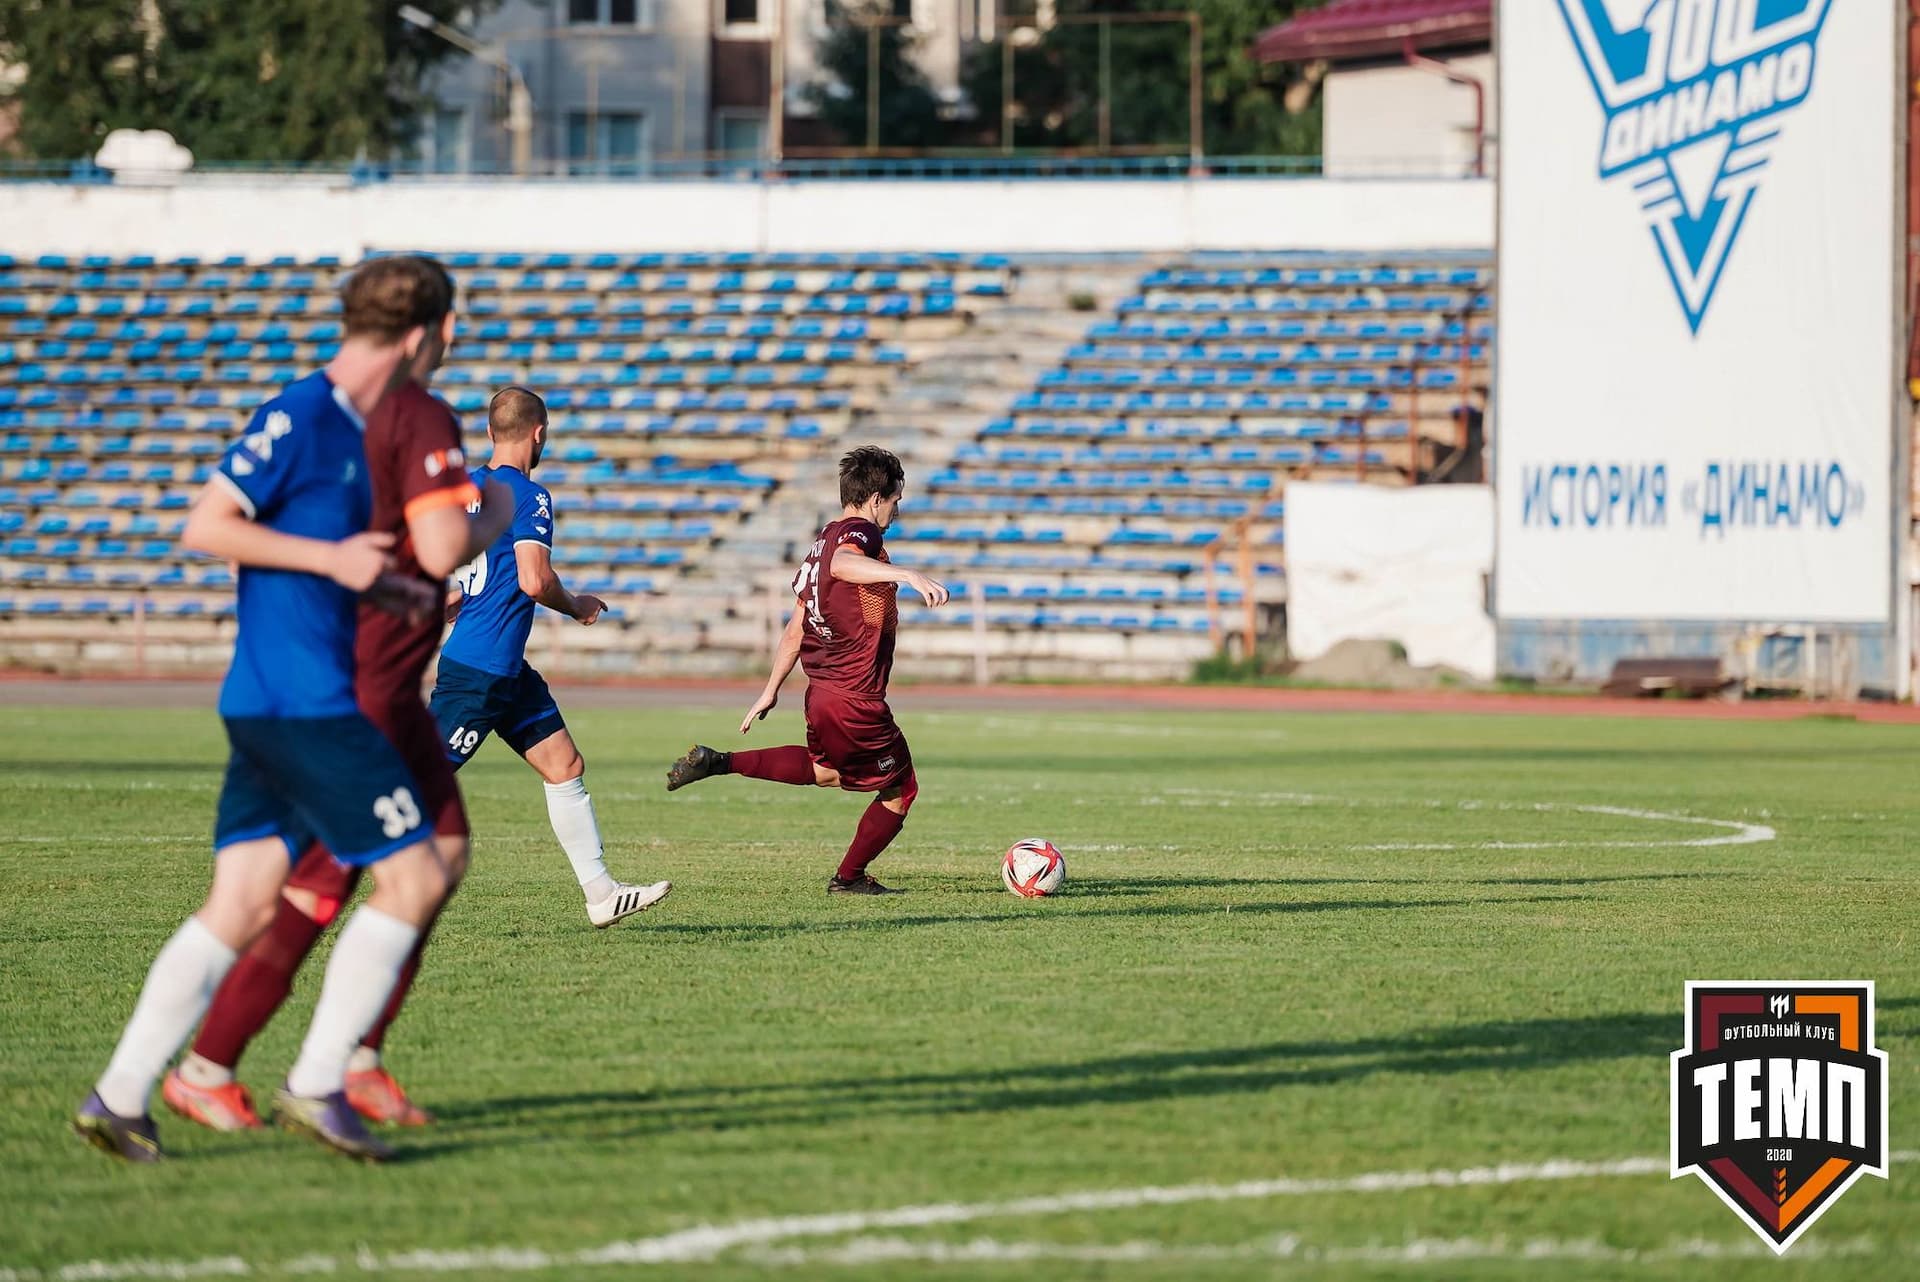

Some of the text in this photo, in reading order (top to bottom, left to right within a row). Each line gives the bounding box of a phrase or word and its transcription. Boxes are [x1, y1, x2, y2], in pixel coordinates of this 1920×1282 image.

[1602, 41, 1812, 170] ДИНАМО
[1522, 461, 1866, 540] ИСТОРИЯ «ДИНАМО»
[449, 726, 478, 754] 49
[373, 786, 421, 838] 33
